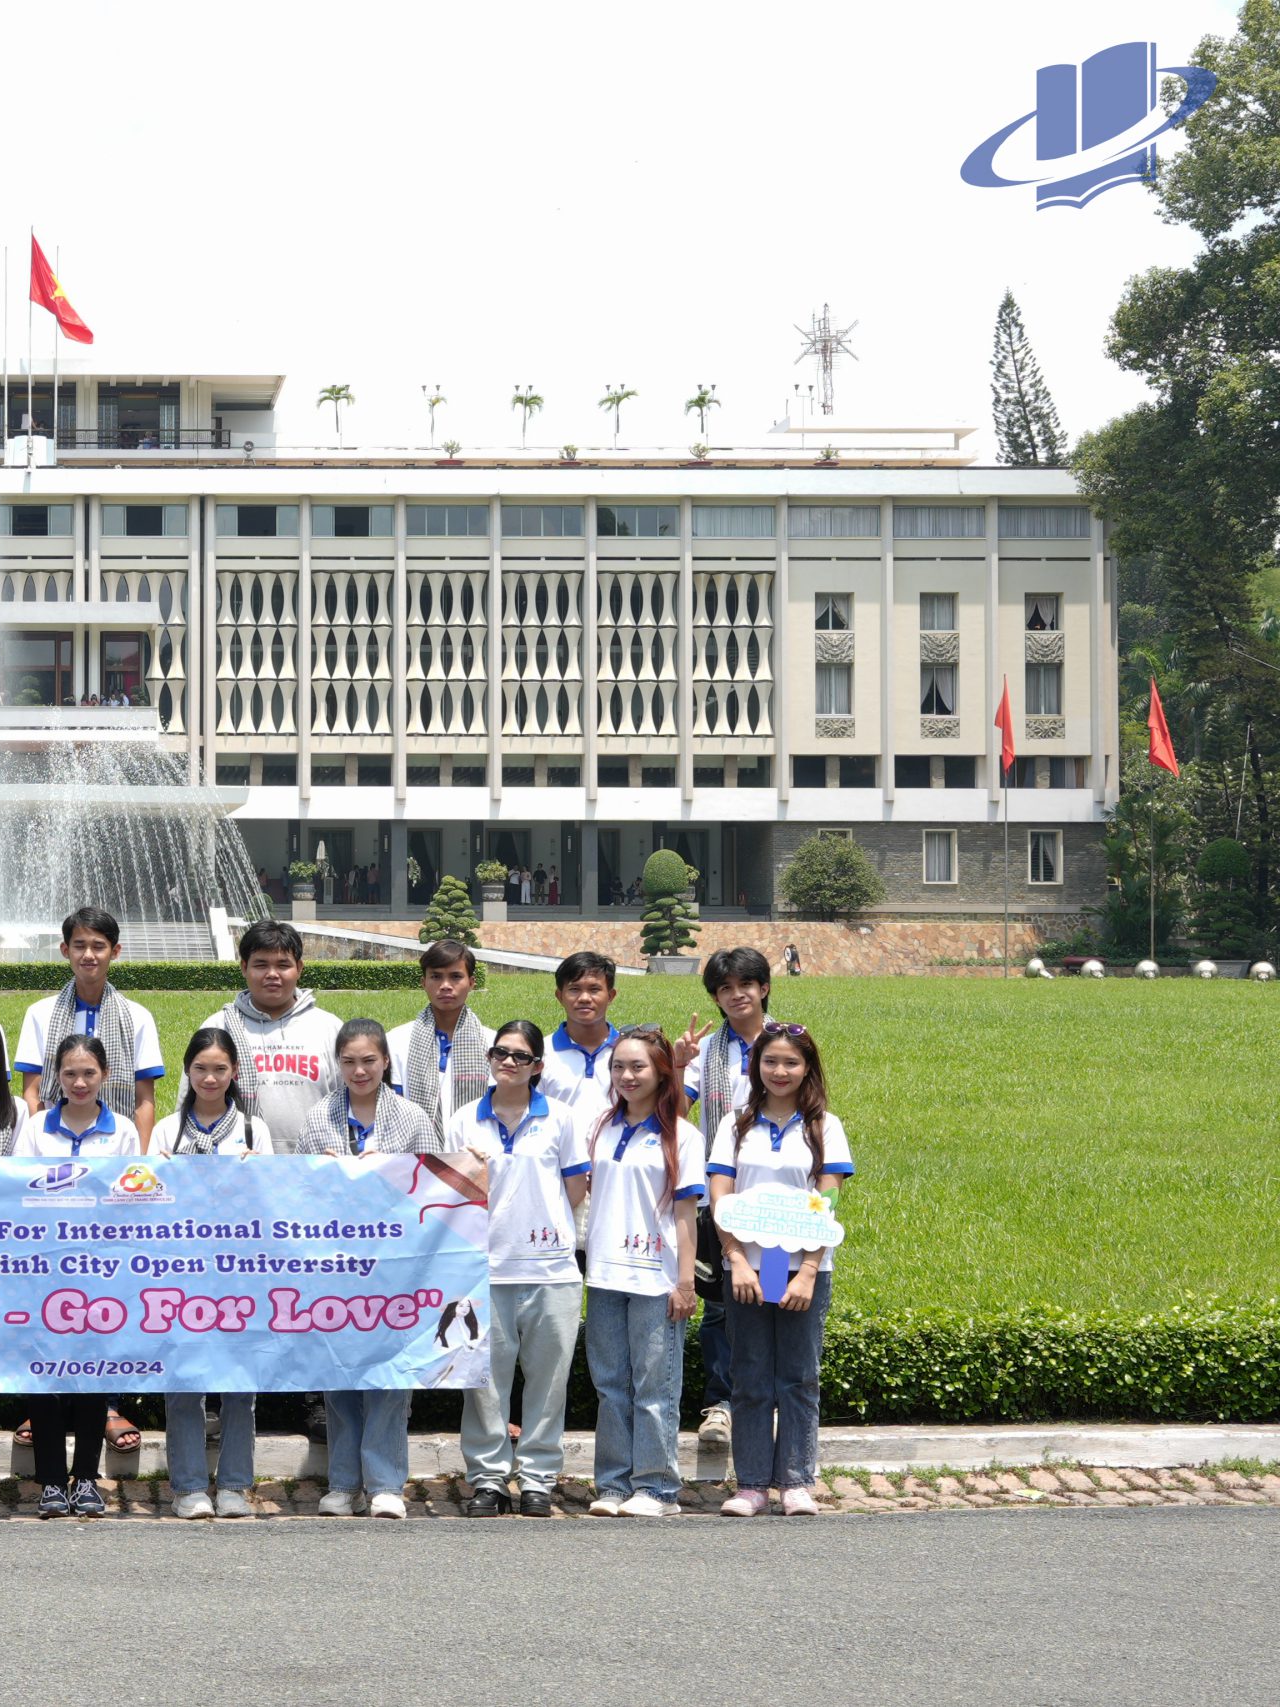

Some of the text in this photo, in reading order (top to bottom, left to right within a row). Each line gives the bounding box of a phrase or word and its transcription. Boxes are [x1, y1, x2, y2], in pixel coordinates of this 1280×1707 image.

[253, 1053, 319, 1082] CLONES
[58, 1219, 262, 1240] International
[273, 1220, 402, 1239] Students
[60, 1254, 120, 1279] City
[130, 1255, 205, 1278] Open
[215, 1253, 376, 1277] University
[4, 1312, 31, 1325] -
[42, 1288, 128, 1335] Go
[140, 1287, 256, 1334] For
[269, 1287, 444, 1334] Love"
[29, 1360, 164, 1377] 07/06/2024
